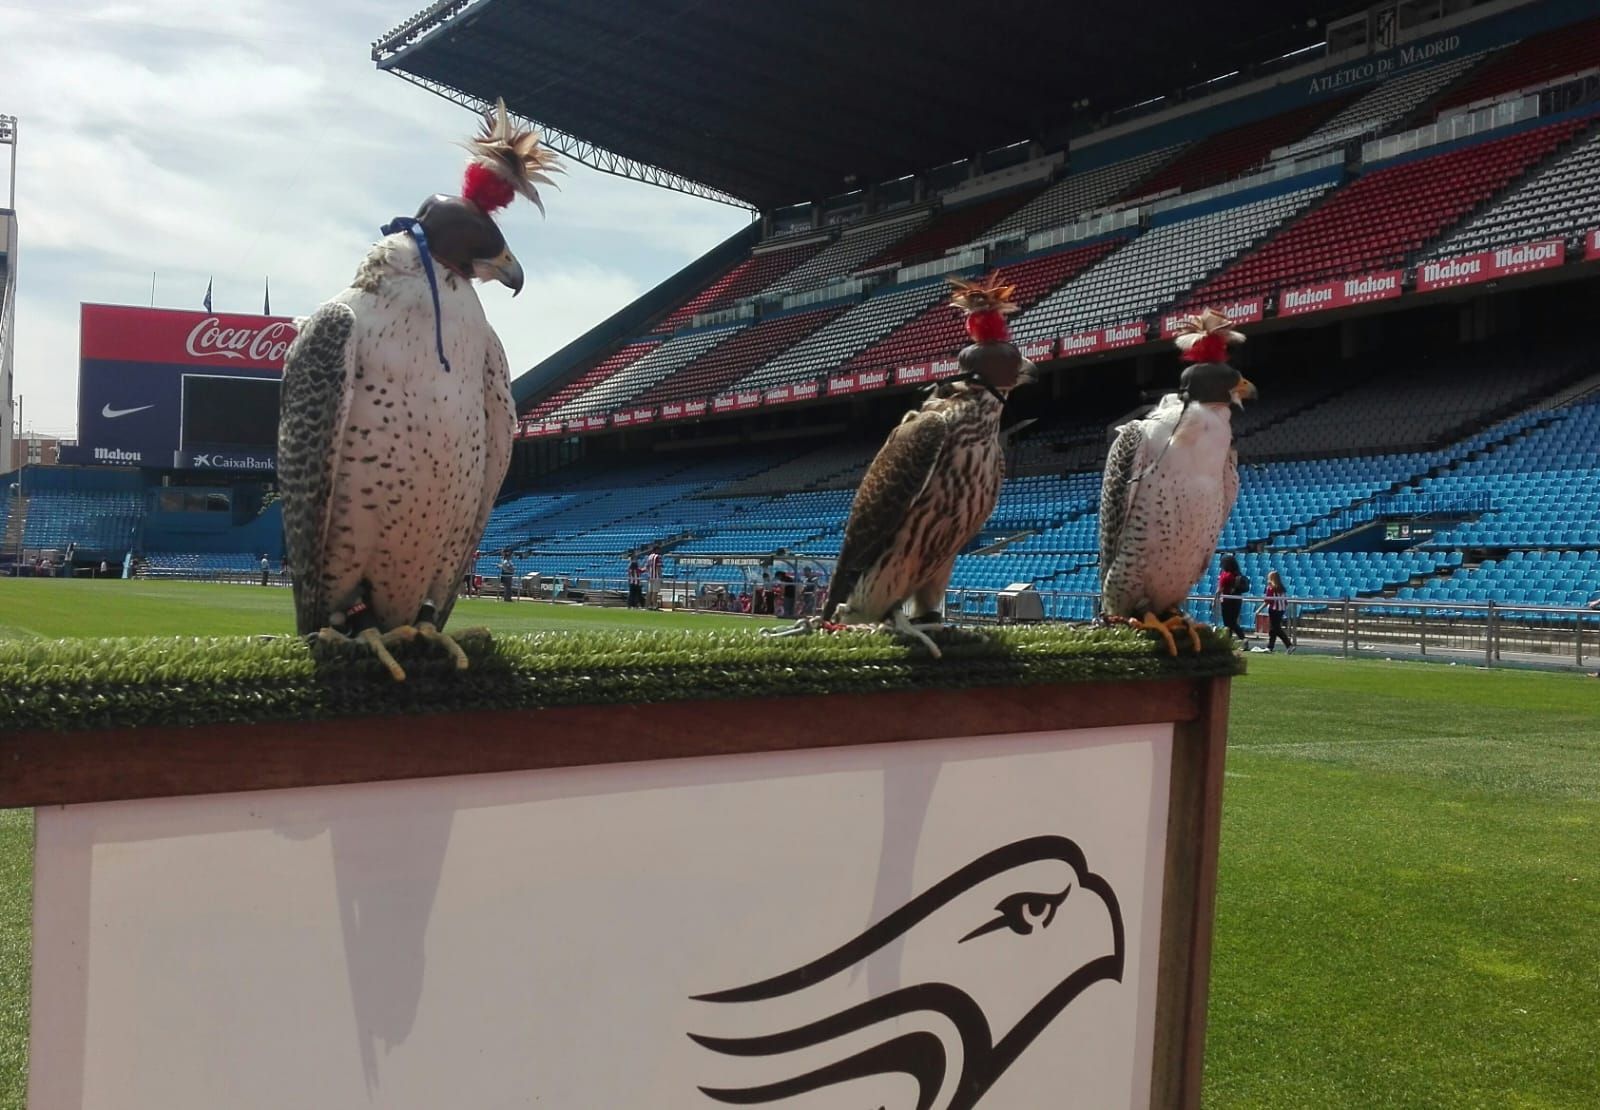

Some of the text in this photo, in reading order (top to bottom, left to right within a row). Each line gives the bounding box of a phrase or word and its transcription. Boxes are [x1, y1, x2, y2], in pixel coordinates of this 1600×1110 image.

[1400, 35, 1461, 66] MADRID
[1424, 243, 1557, 282] Mahou Mahou
[1285, 275, 1395, 308] Mahou Mahou
[1224, 302, 1258, 318] ahou
[186, 317, 299, 361] Coca-Co
[1063, 325, 1143, 350] Mahou Mahou
[898, 360, 960, 379] Mahou Mahou
[794, 384, 817, 396] Mahou
[830, 372, 884, 390] Mahou Mahou
[94, 447, 141, 461] Mahou
[212, 455, 275, 470] CaixaBank
